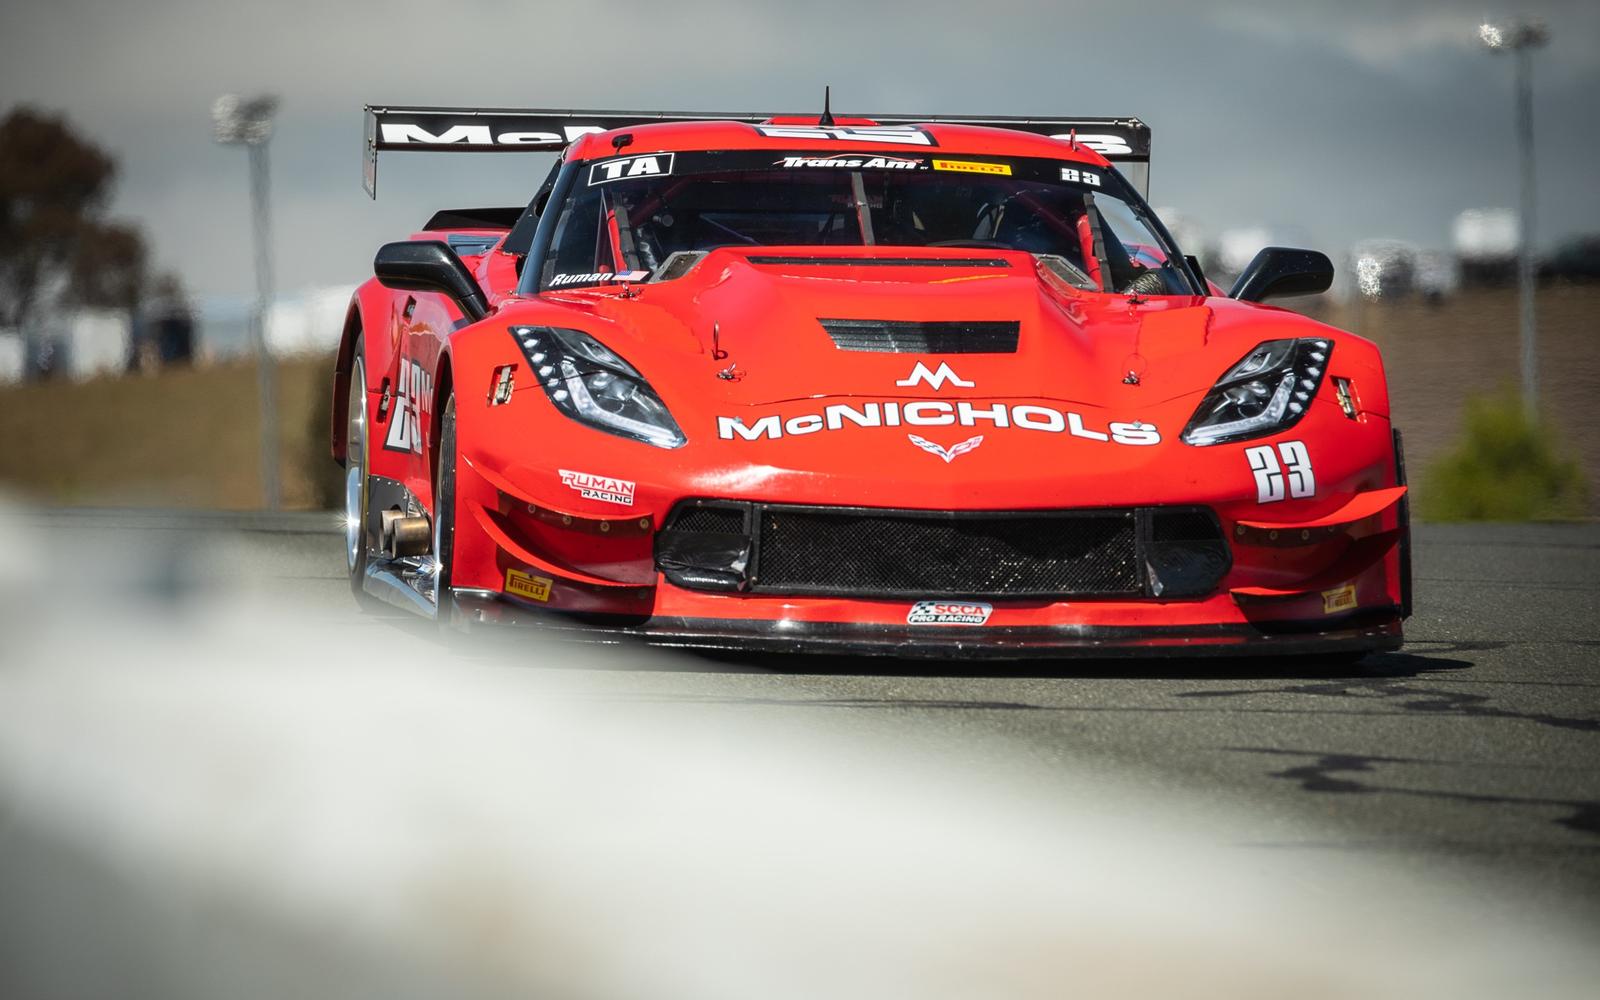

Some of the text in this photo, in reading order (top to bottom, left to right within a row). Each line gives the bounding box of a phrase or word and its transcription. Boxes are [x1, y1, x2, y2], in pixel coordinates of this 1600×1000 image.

[601, 156, 659, 180] TA
[783, 156, 861, 168] Trans
[862, 157, 917, 169] Am
[548, 272, 614, 287] Ruman
[717, 402, 1162, 446] McNICHOLS
[1244, 440, 1316, 505] 23
[562, 472, 634, 493] RUMAN
[582, 489, 632, 504] RACING
[934, 604, 984, 615] SCCA
[937, 615, 983, 623] RACING
